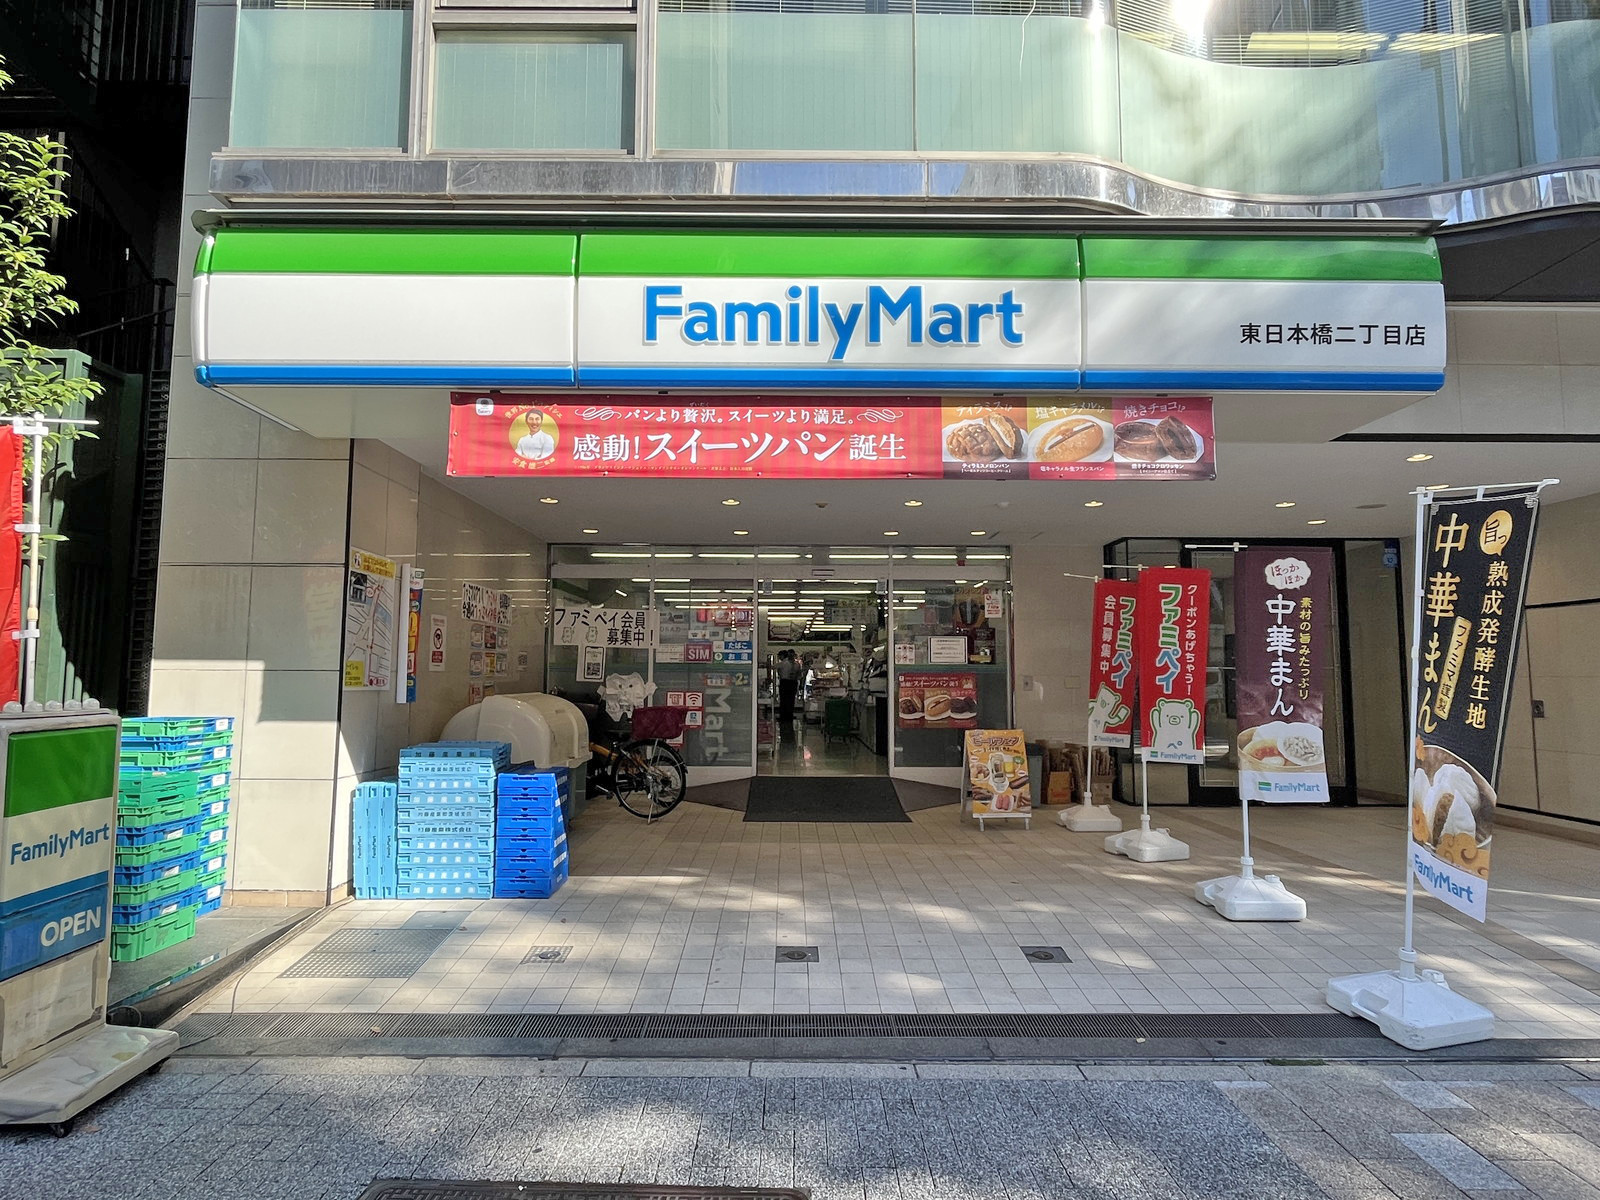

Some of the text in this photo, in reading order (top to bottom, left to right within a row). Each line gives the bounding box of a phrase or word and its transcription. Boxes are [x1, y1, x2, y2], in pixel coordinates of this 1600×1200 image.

[643, 285, 1024, 361] FamilyMart
[1240, 323, 1426, 346] 東日本橋二丁目店
[554, 608, 646, 629] ファミペイ会員
[607, 629, 654, 646] 募集中!
[728, 641, 748, 649] たばこ
[1099, 594, 1117, 674] 会員募集中
[1111, 596, 1137, 689] ファミペイ
[1156, 583, 1182, 694] ファミペイ
[1184, 584, 1198, 695] クーポンあげちゃう!
[1298, 596, 1313, 700] 素材の旨みたっぷり
[1417, 512, 1470, 734] 中華まん
[1465, 561, 1509, 730] 熟成発酵生地
[688, 649, 710, 660] SIM
[1265, 593, 1297, 716] 中華まん
[1160, 751, 1197, 762] FamilyMart
[1274, 781, 1320, 793] FamilyMart
[10, 823, 110, 866] FamilyMart
[40, 906, 102, 947] OPEN
